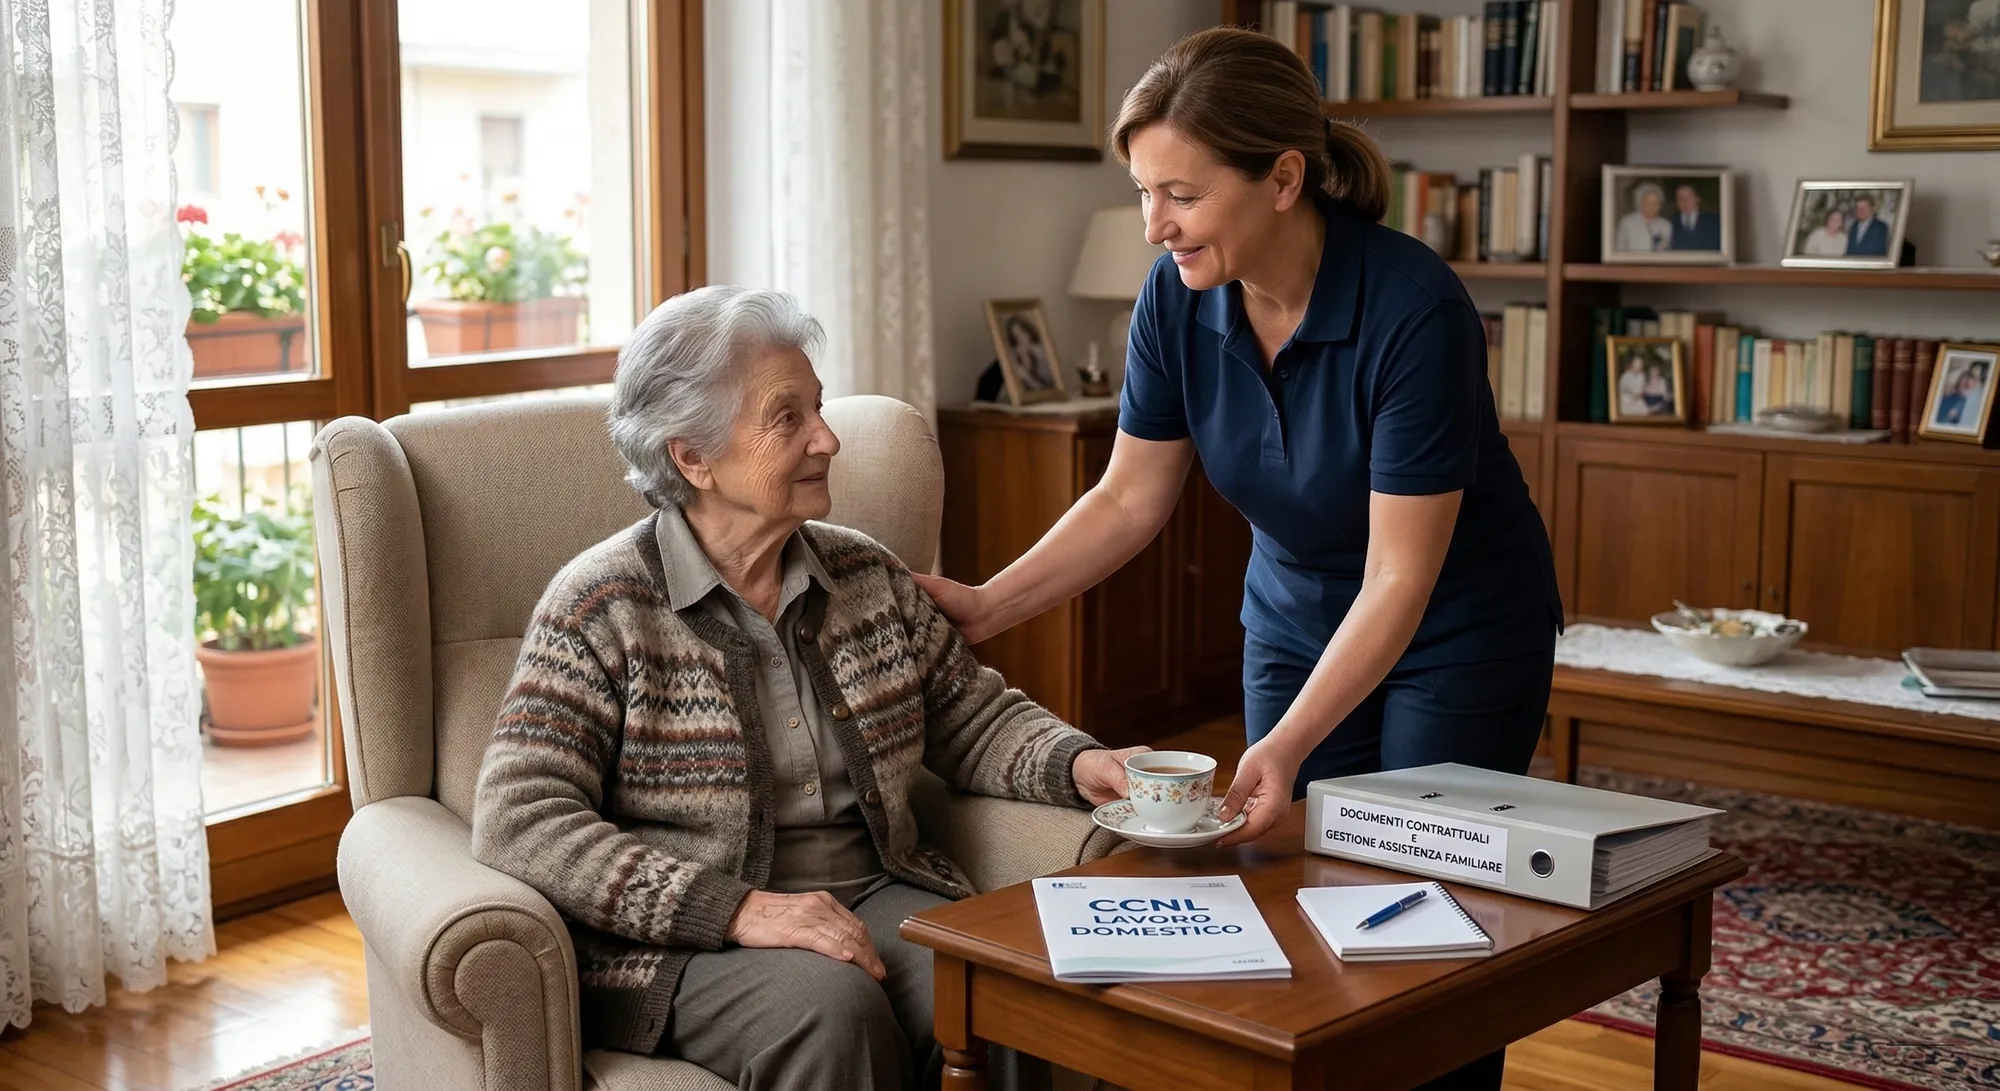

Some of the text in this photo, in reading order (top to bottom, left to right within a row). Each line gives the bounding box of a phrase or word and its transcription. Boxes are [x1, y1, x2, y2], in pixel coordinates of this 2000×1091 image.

[1340, 807, 1490, 844] DOCUMENTI CONTRATTUALI
[1411, 834, 1417, 842] E
[1326, 829, 1502, 873] GESTIONE ASSISTENZA FAMILIARE
[1088, 898, 1210, 912] CCNL
[1094, 914, 1211, 924] LAVORO
[1071, 925, 1243, 936] DOMESTICO
